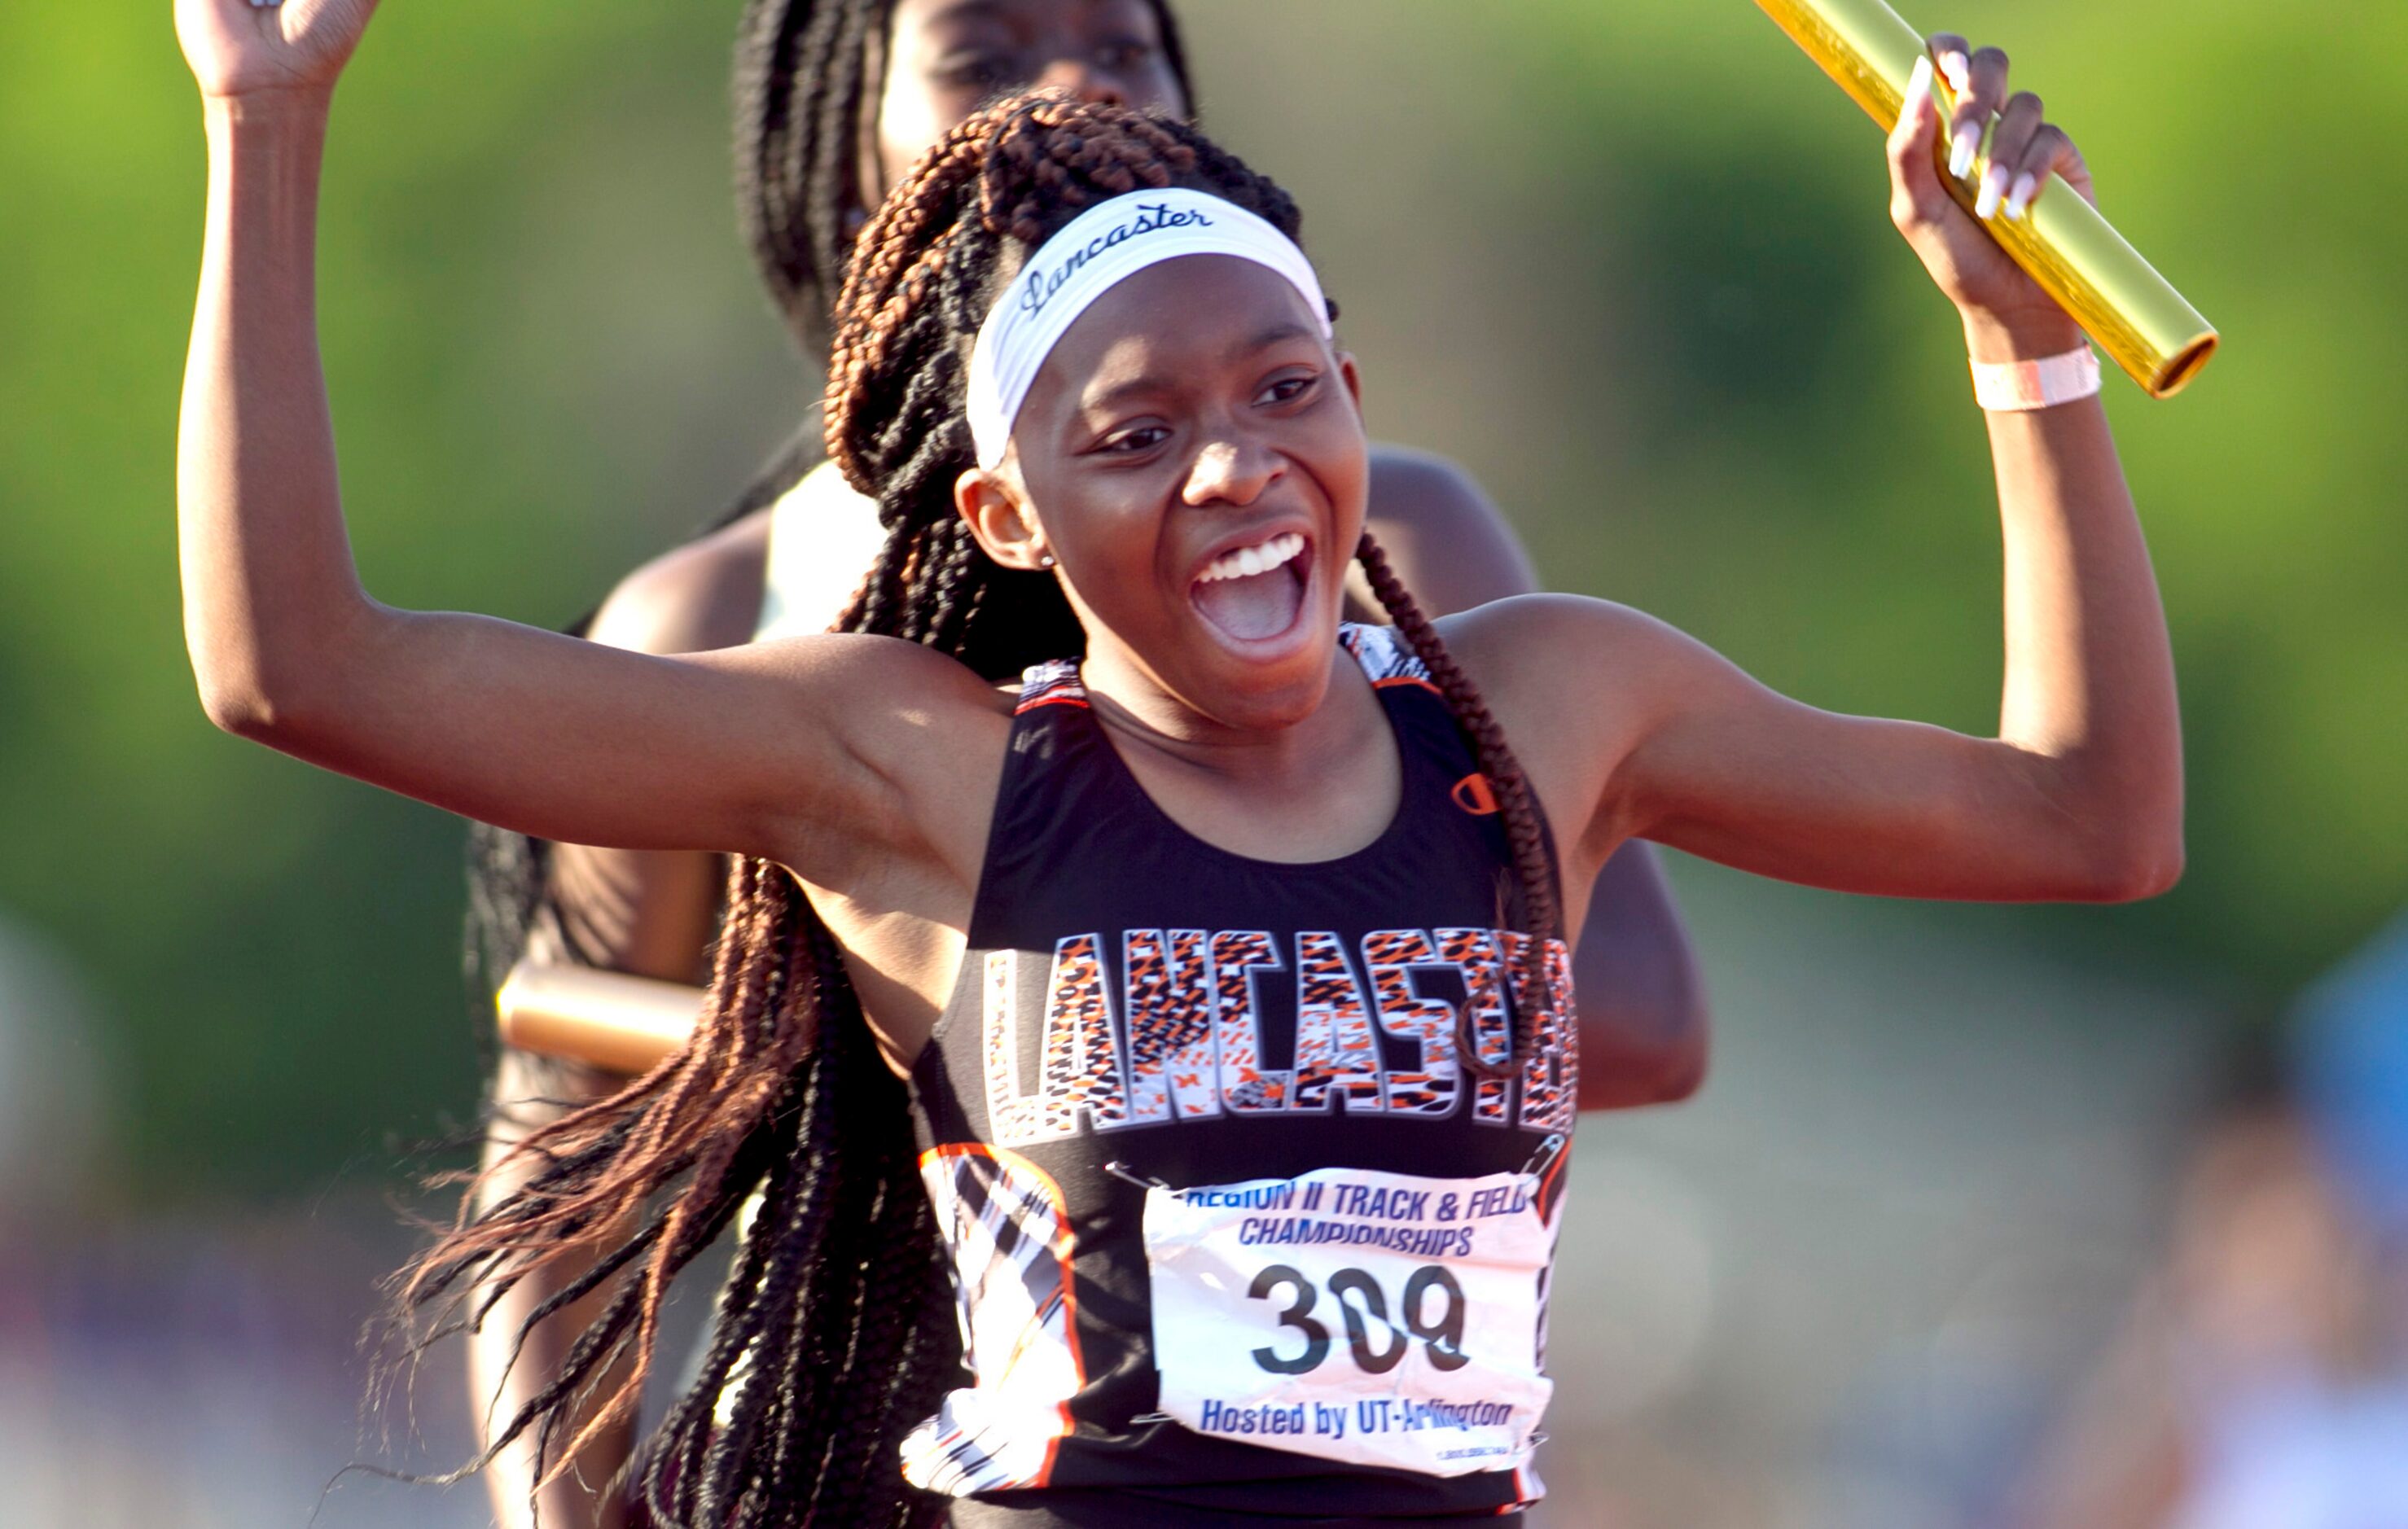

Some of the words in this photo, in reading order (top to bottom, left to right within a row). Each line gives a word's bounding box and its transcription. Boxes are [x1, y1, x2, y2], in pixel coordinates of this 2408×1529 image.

[1020, 203, 1214, 321] Lancaster
[1333, 1183, 1432, 1222] TRACK
[1434, 1192, 1460, 1222] &
[1464, 1185, 1527, 1220] FIELD
[1239, 1217, 1475, 1257] CHAMPIONSHIPS
[1247, 1264, 1471, 1374] 309
[1200, 1399, 1305, 1435] Hosted
[1314, 1401, 1348, 1440] by
[1358, 1398, 1514, 1435] UT-Arlington
